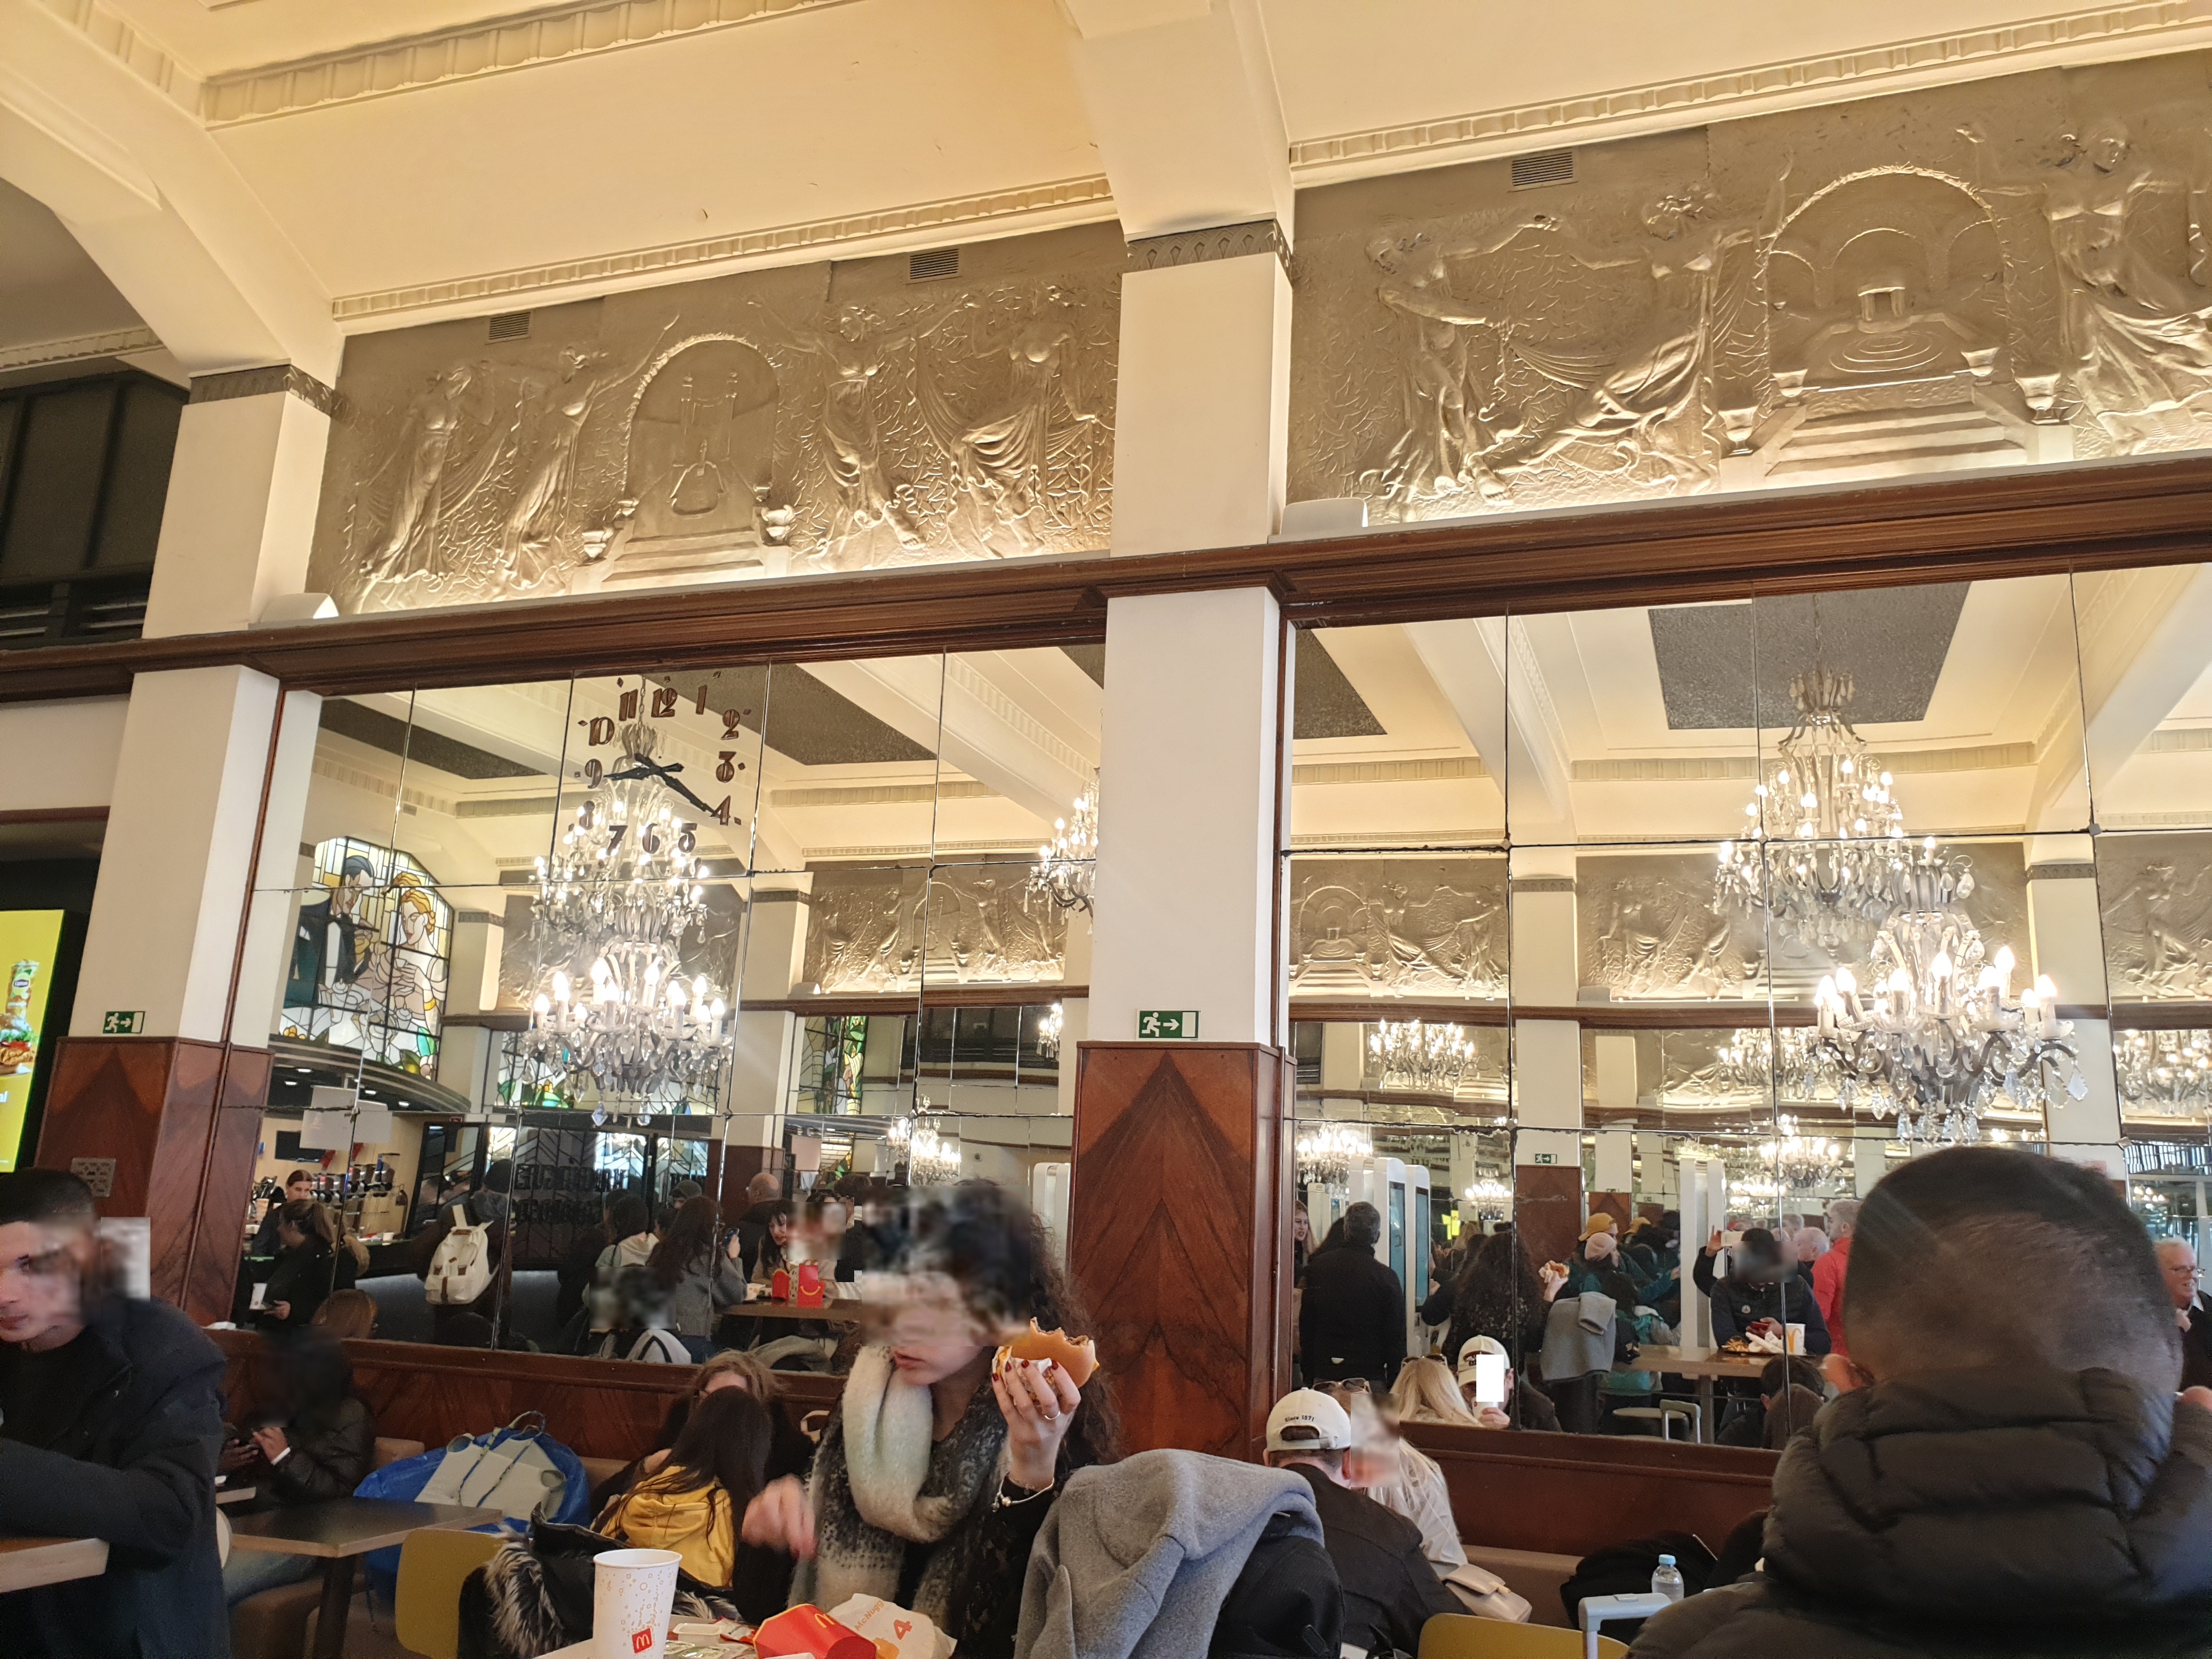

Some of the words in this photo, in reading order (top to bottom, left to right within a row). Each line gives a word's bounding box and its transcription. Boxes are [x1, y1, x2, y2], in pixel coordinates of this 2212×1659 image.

[619, 689, 638, 721] 11
[651, 688, 678, 718] 12
[696, 685, 707, 715] 1
[589, 716, 614, 746] 10
[721, 709, 740, 740] 2
[585, 759, 603, 789] 9
[715, 751, 737, 783] 3
[709, 795, 731, 826] 4
[606, 825, 628, 856] 7
[642, 823, 661, 854] 6
[678, 823, 697, 853] 5
[894, 1619, 913, 1640] 4
